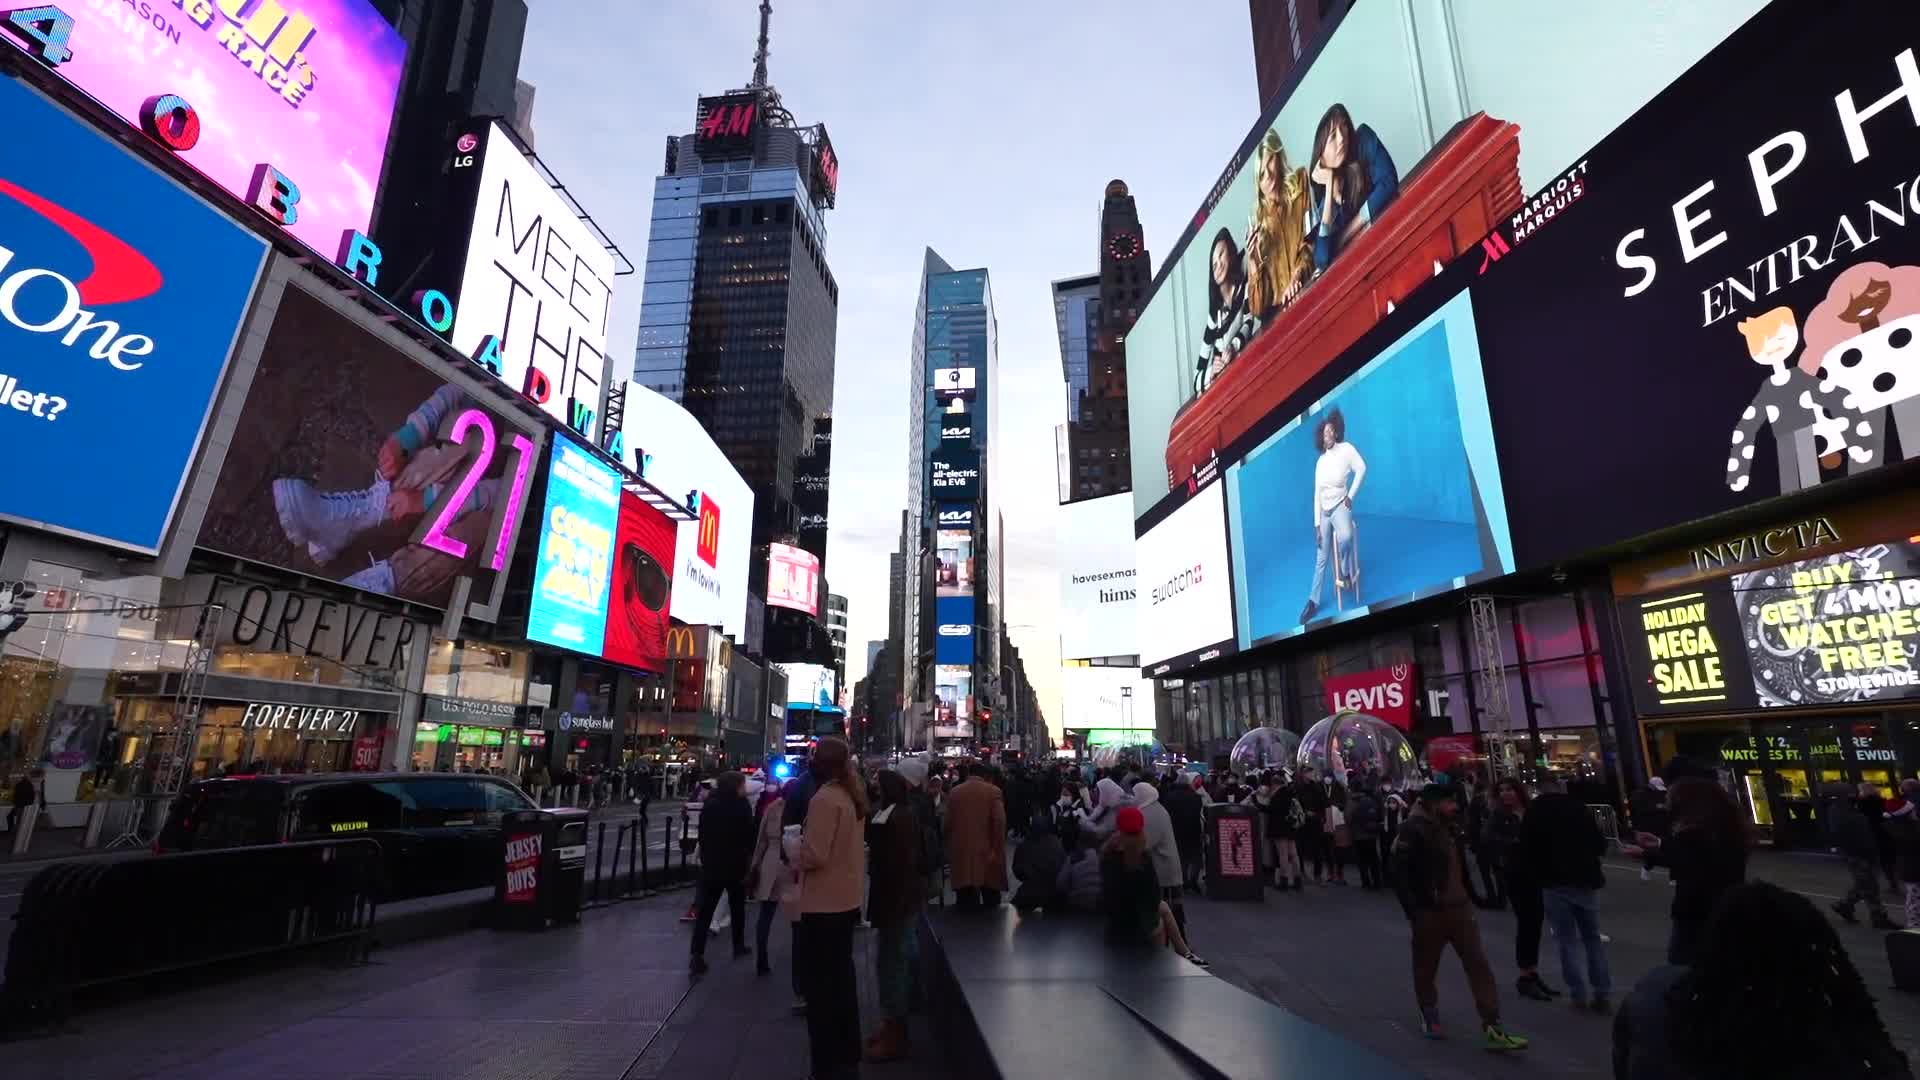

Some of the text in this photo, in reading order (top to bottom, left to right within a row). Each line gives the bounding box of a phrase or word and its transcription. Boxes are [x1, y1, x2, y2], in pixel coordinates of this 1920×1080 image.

[216, 24, 306, 108] RACE
[702, 104, 754, 138] H&M
[455, 156, 473, 168] LG
[1616, 48, 1920, 297] SEPH
[1512, 160, 1588, 228] MARRIOTT
[1515, 184, 1582, 242] MARQUIS
[496, 178, 613, 336] MEET
[246, 163, 654, 478] BROADWAY
[494, 259, 604, 404] THE
[933, 462, 950, 470] The
[933, 470, 978, 478] all-electric
[933, 478, 966, 487] Kia EV6
[421, 409, 534, 571] 21
[1690, 517, 1842, 571] INVICTA
[1152, 568, 1194, 605] swatch
[1792, 561, 1852, 594] BUY
[1099, 588, 1137, 604] hims
[1762, 597, 1816, 626] GET
[1824, 592, 1843, 616] 4
[195, 574, 415, 671] FOREVER
[1643, 602, 1706, 631] HOLIDAY
[1647, 626, 1718, 660] MEGA
[1820, 640, 1909, 672] FREE
[1653, 657, 1726, 694] SALE
[1816, 670, 1920, 693] STOREWIDE
[241, 703, 360, 732] FOREVER 21
[572, 715, 614, 731] sunglass hut
[505, 832, 542, 863] JERSEY
[507, 866, 536, 893] BOYS
